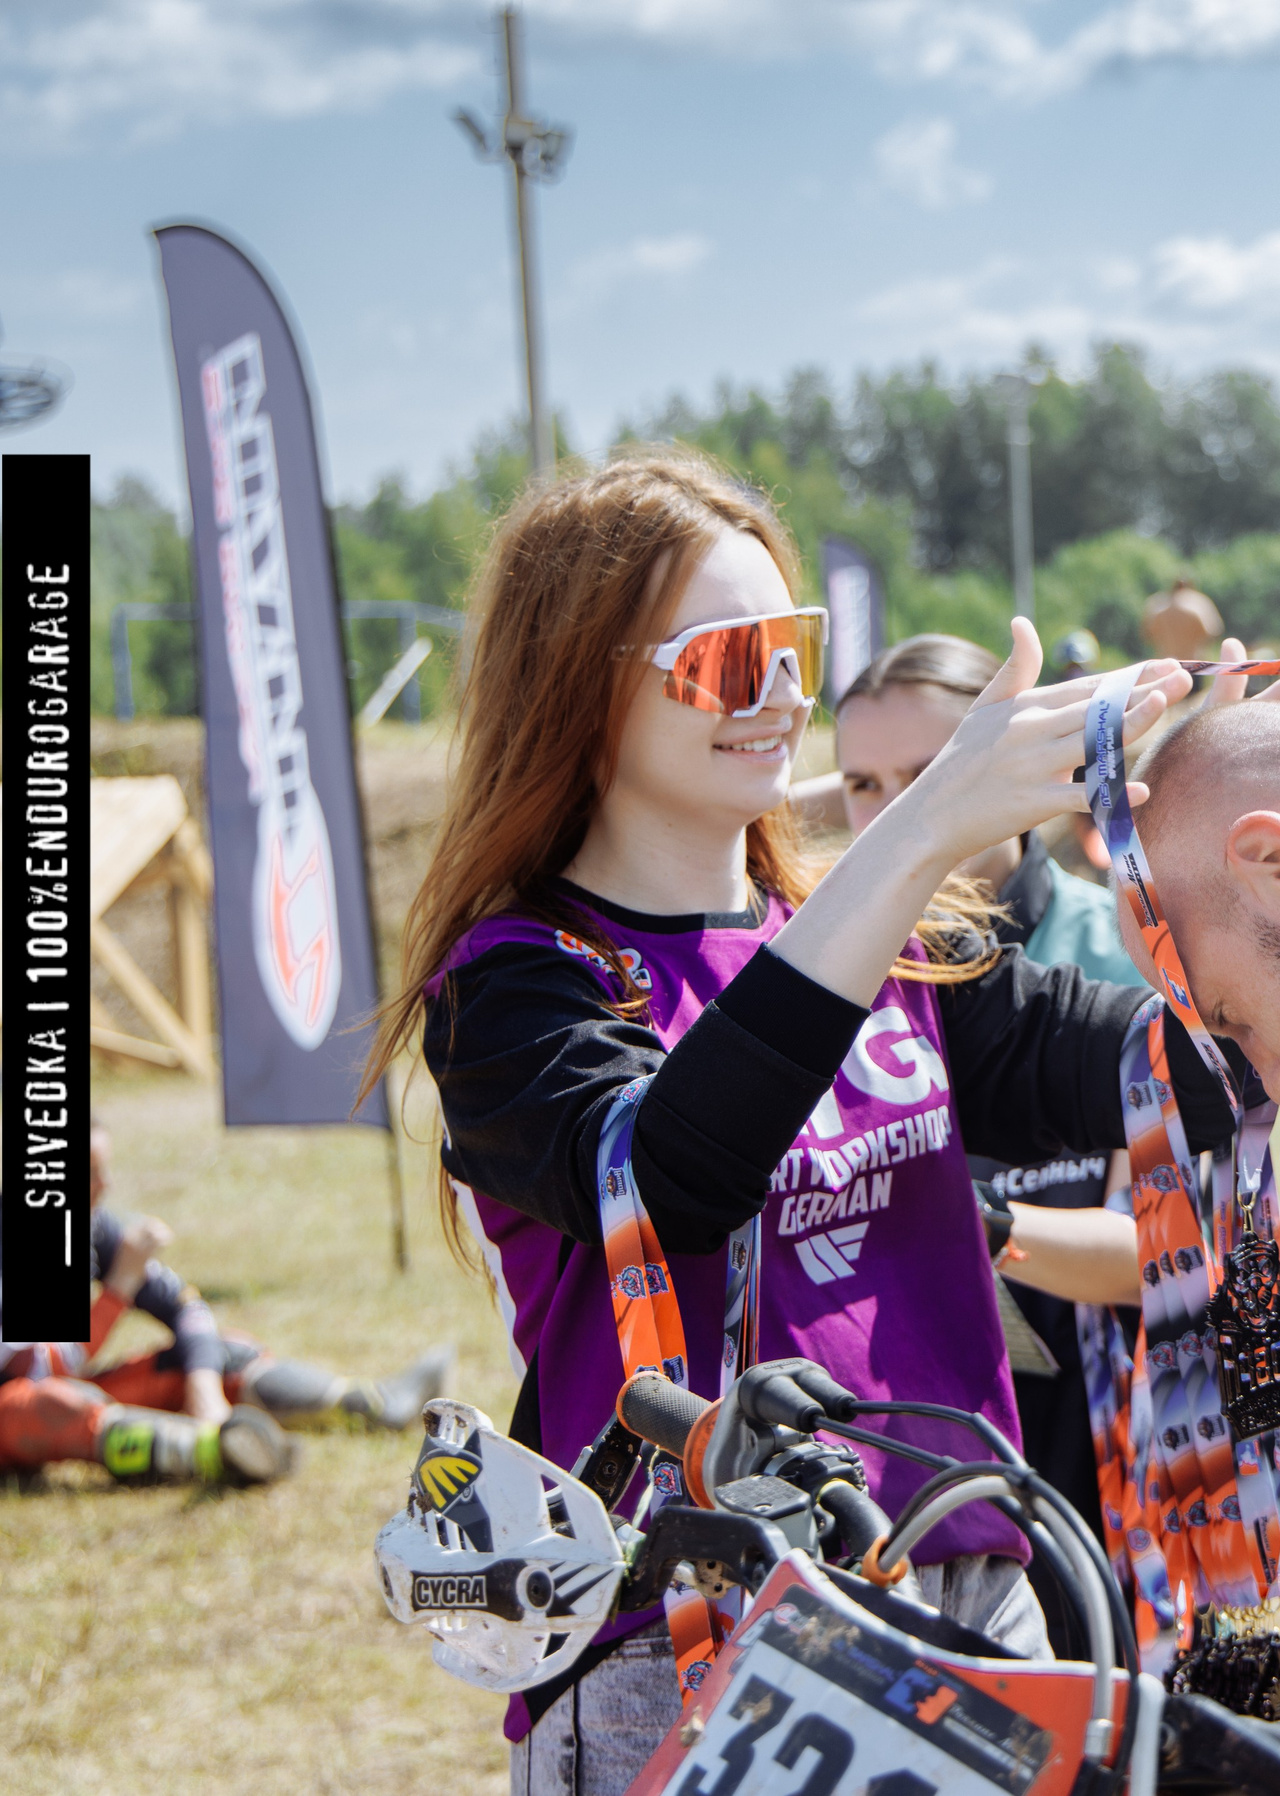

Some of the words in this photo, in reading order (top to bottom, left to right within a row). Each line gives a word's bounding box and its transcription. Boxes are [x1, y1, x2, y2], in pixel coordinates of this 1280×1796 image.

[807, 1104, 952, 1189] WORKSHOP
[777, 1169, 893, 1236] GERMAN
[413, 1574, 488, 1607] CYCRA
